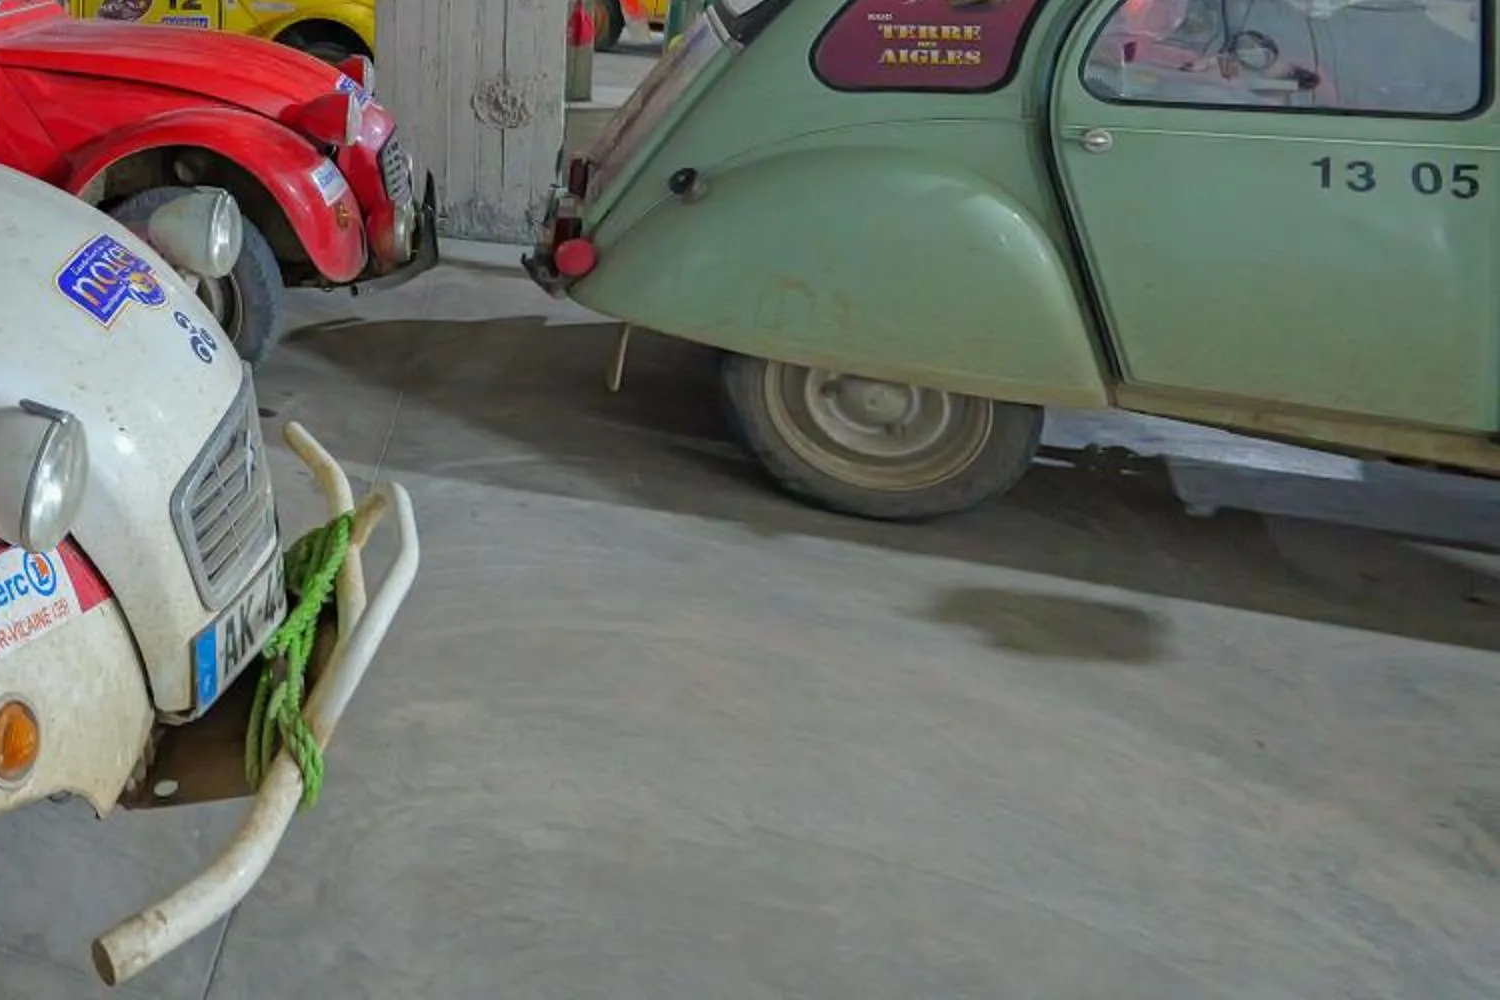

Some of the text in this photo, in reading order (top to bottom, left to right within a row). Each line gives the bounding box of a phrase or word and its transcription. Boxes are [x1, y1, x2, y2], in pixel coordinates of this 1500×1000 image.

[878, 24, 981, 40] TERRE
[878, 49, 981, 65] AIGLES
[1311, 157, 1480, 199] 13 05
